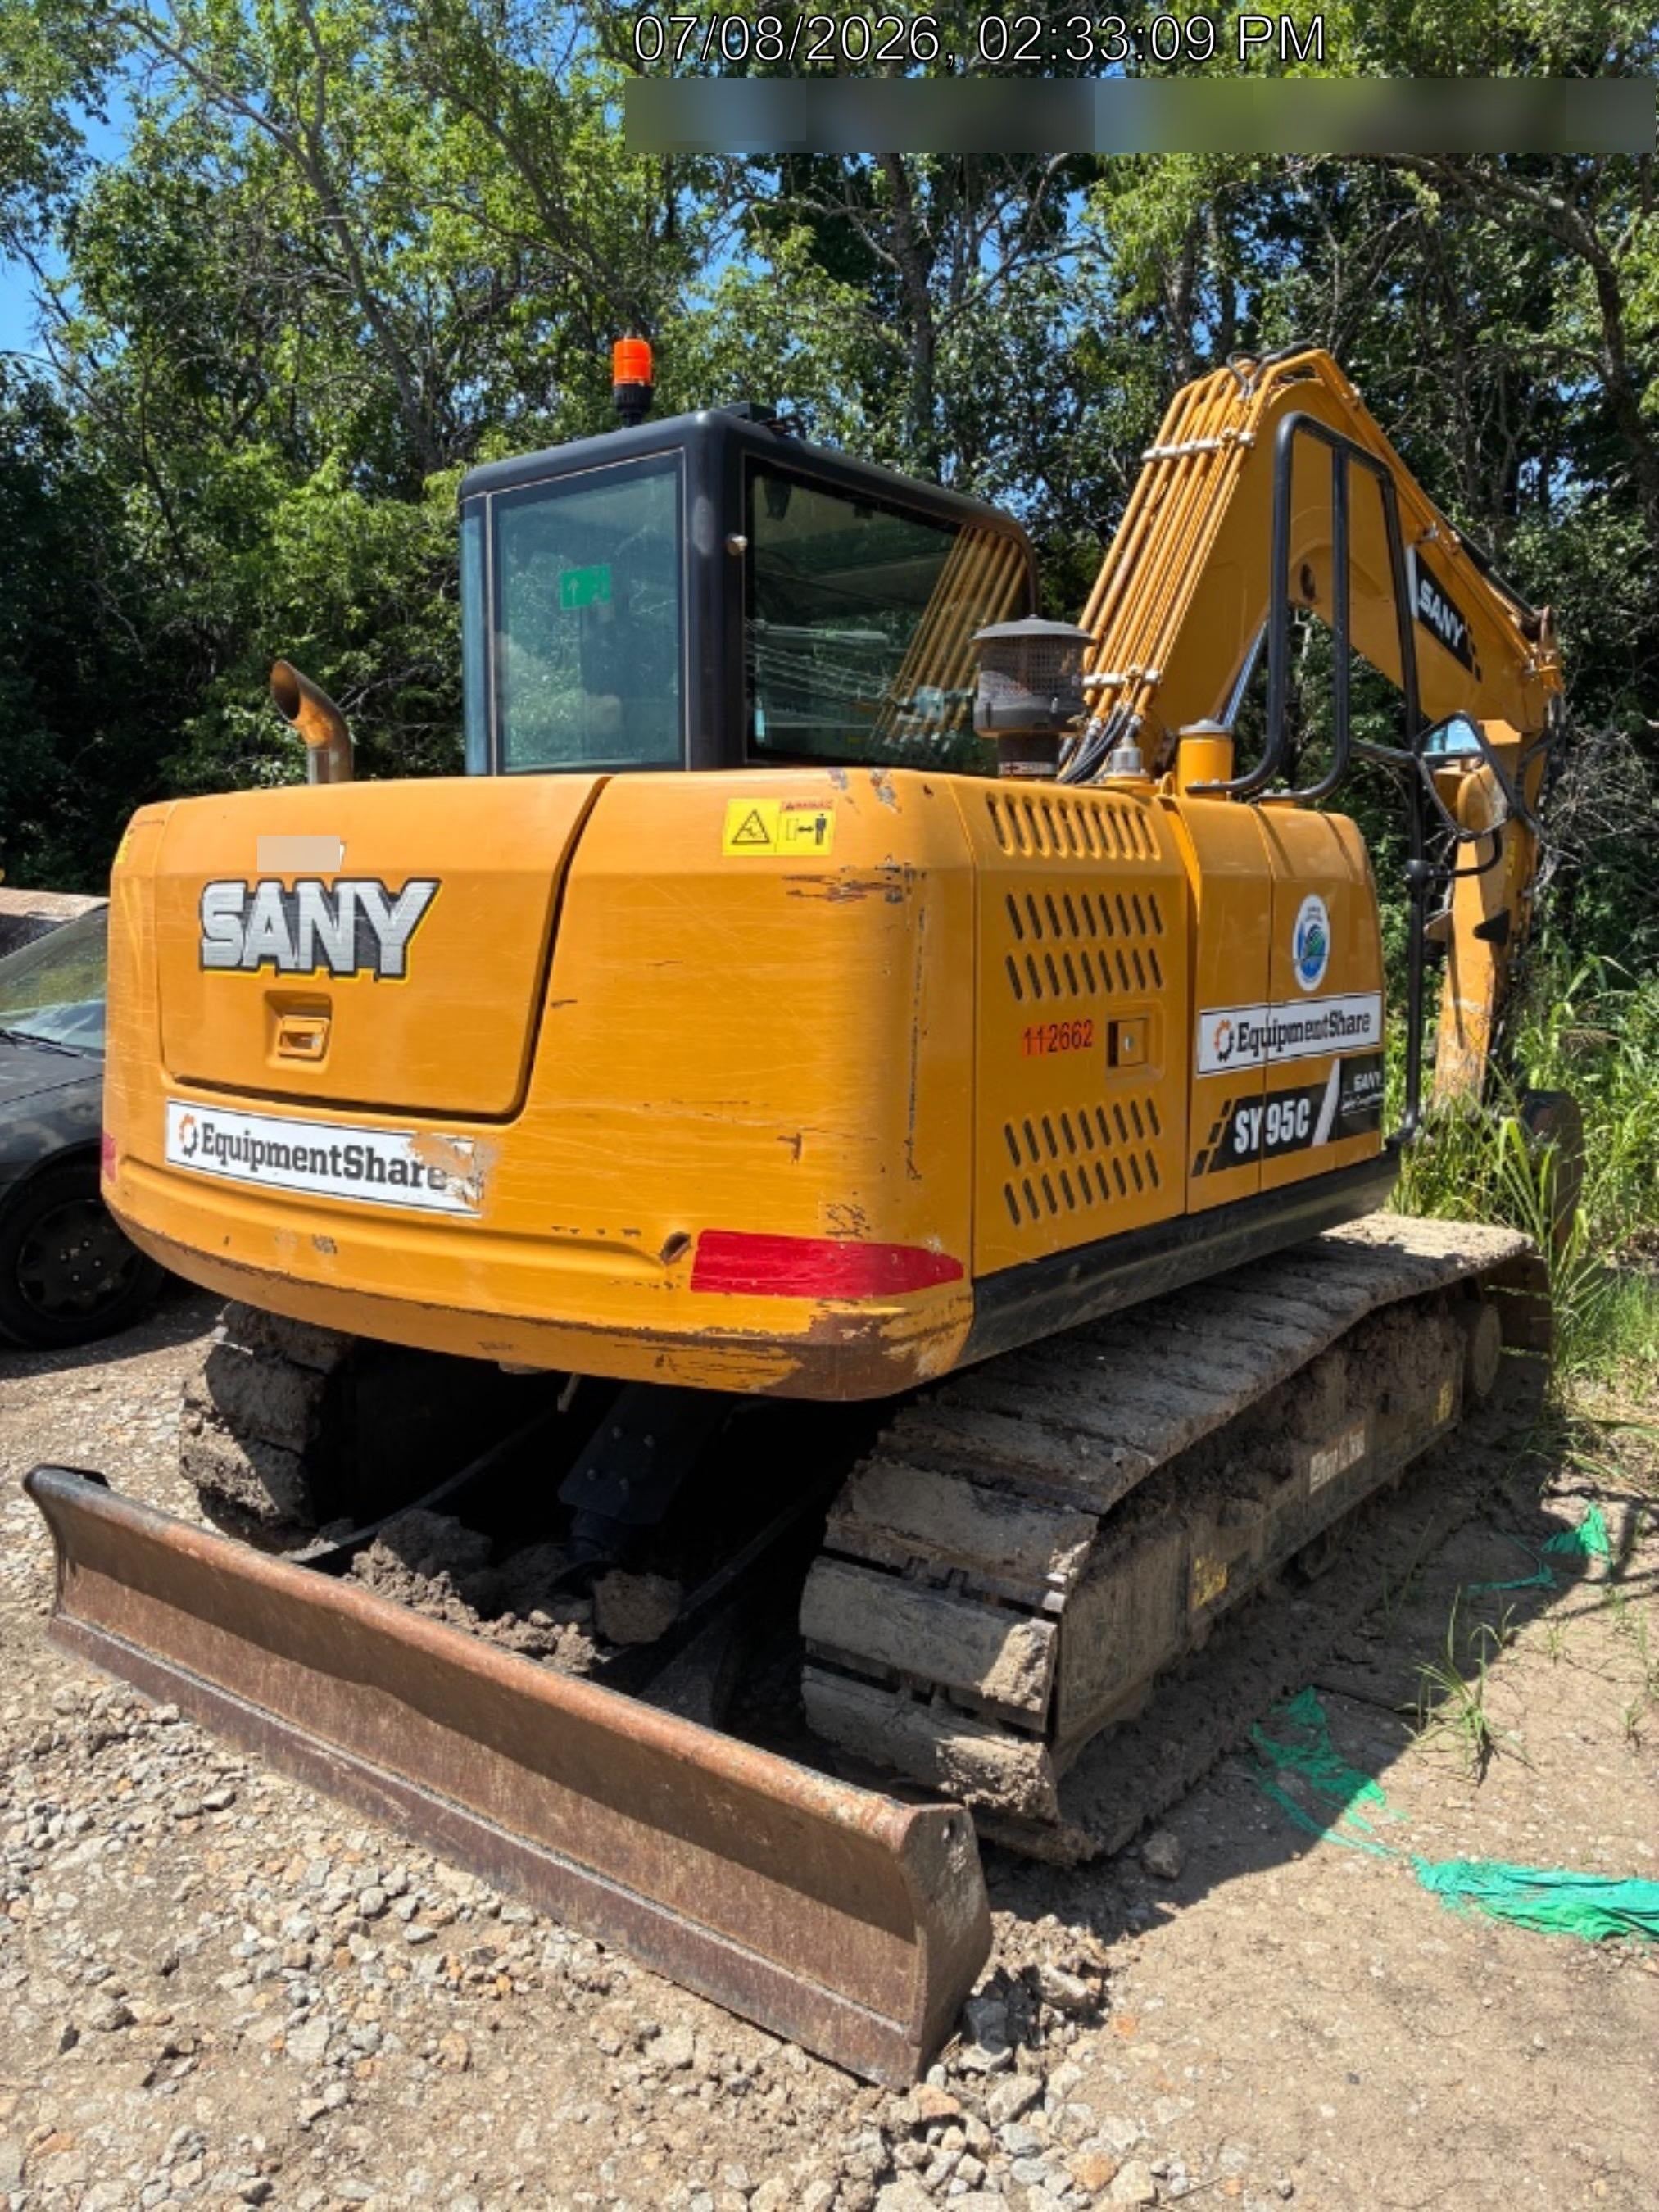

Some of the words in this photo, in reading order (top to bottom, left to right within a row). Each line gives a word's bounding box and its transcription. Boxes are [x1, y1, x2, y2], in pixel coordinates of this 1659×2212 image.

[1418, 578, 1466, 648] SANY
[199, 878, 442, 983] SANY
[1023, 1018, 1093, 1056] 112662
[1235, 1009, 1371, 1058] EquipmentShare
[201, 1122, 449, 1191] EquipmentShare
